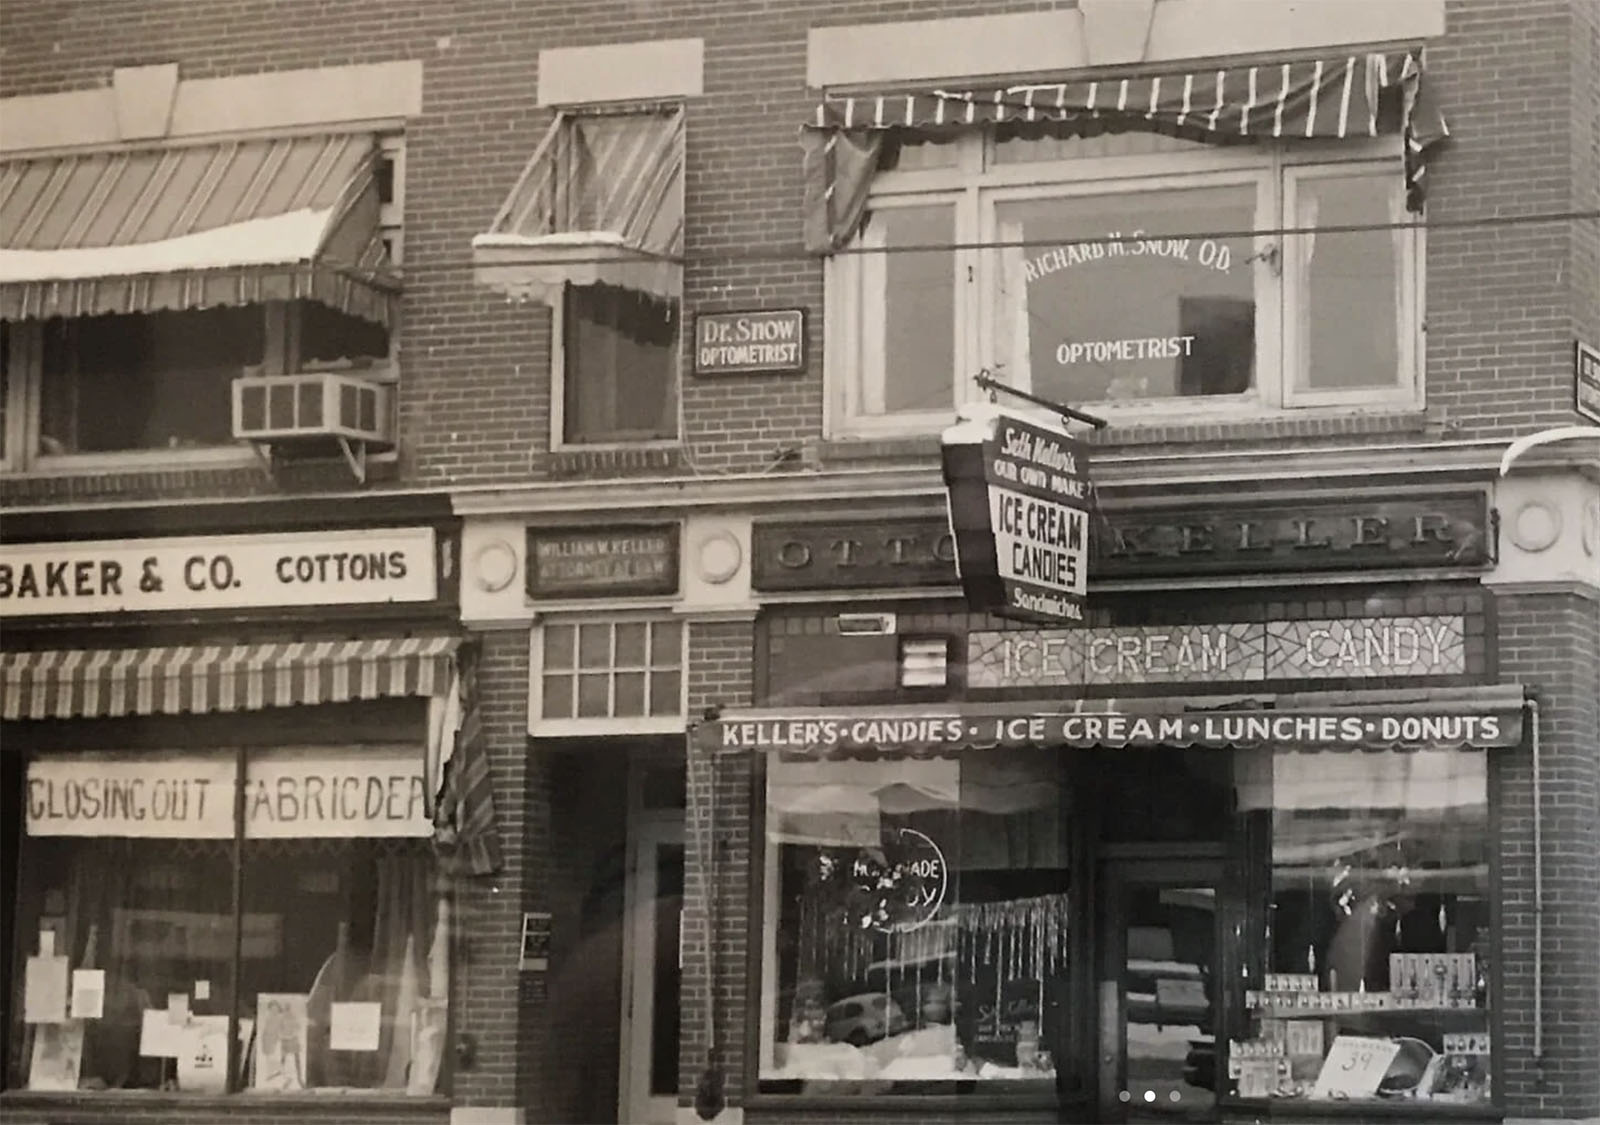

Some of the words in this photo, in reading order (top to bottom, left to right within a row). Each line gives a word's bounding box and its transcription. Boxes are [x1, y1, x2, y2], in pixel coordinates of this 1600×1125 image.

[1025, 243, 1105, 282] RICHARD
[704, 320, 732, 343] Dr.
[1056, 336, 1195, 365] OPTOMETRIST
[701, 343, 798, 366] OPTOMETRIST
[994, 459, 1018, 481] OUR
[1051, 474, 1085, 499] MAKE
[999, 493, 1023, 537] ICE
[1026, 502, 1082, 551] CREAM
[1109, 513, 1456, 558] KELLER
[0, 560, 123, 598] BAKER
[139, 556, 163, 592] &
[184, 555, 241, 591] CO.
[276, 551, 407, 584] COTTONS
[1013, 541, 1077, 587] CANDIES
[1003, 639, 1066, 678] ICE
[1090, 633, 1227, 675] CREAM
[1306, 626, 1447, 667] CANDY
[723, 721, 837, 746] KELLER'S
[851, 720, 962, 743] CANDIES
[996, 719, 1045, 741] ICE
[1063, 717, 1183, 741] CREAM
[1205, 716, 1362, 740] LUNCHES
[1382, 716, 1500, 740] DONUTS
[28, 777, 145, 821] CLOSING
[152, 778, 210, 821] OUT
